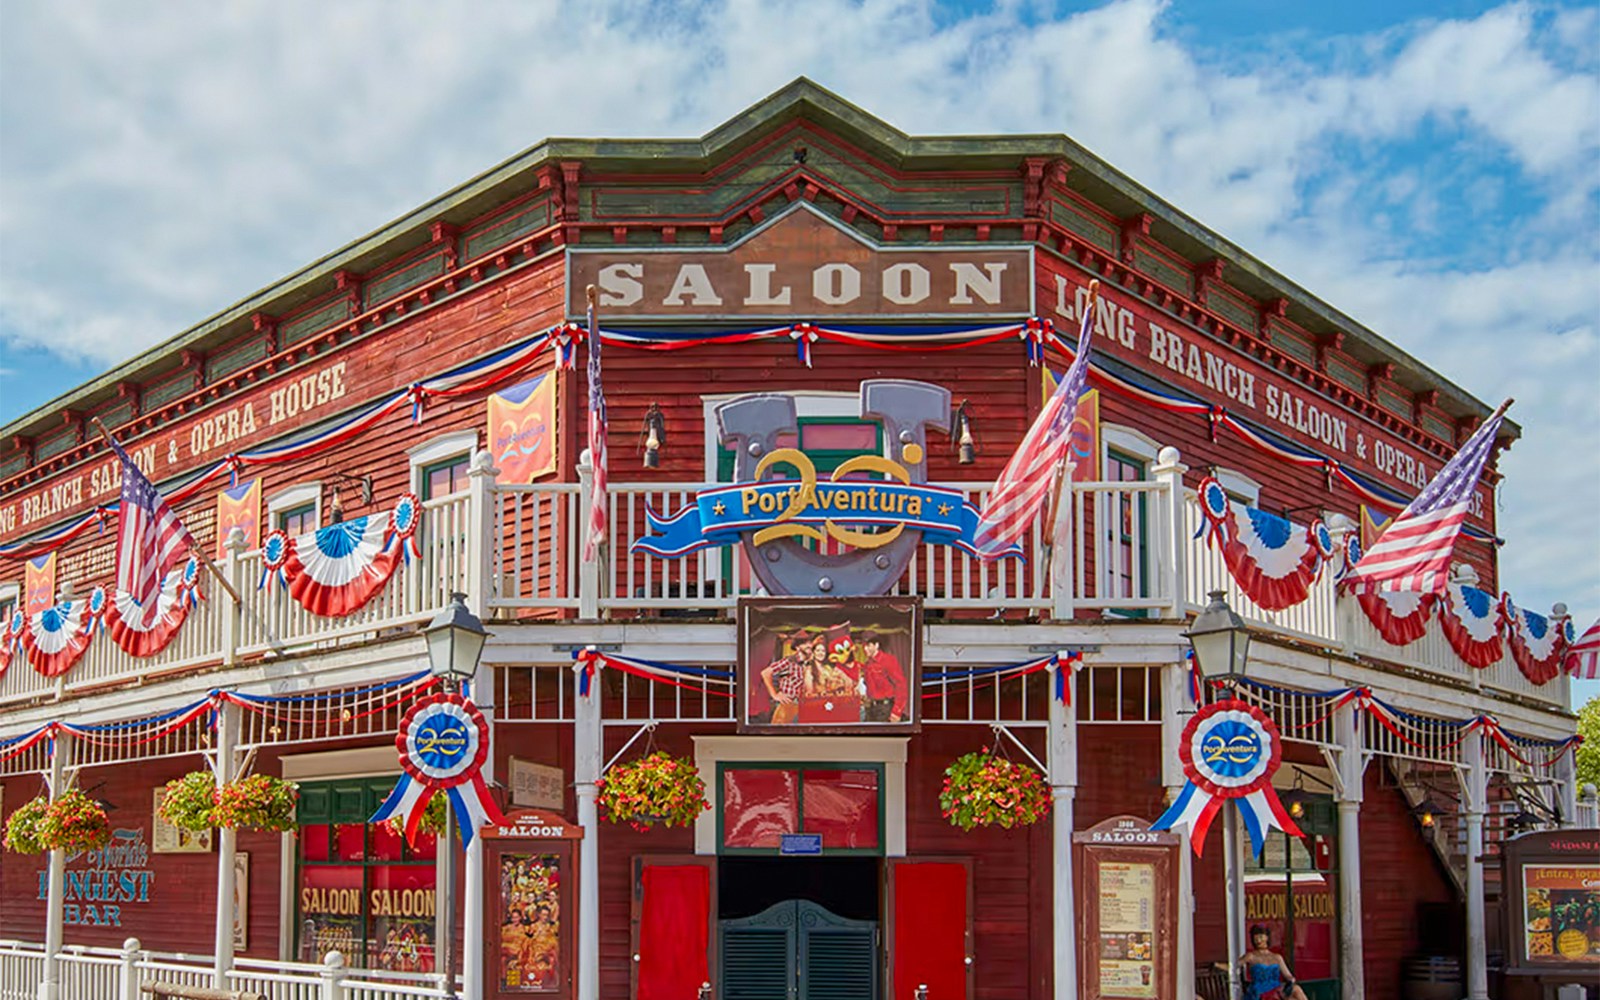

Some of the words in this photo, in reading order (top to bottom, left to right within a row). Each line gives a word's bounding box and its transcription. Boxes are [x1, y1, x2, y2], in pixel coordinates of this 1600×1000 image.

[599, 263, 1008, 306] SALOON
[1055, 274, 1136, 350] LONG
[1149, 322, 1256, 409] BRANCH
[1265, 384, 1348, 453] SALOON
[1356, 433, 1367, 460] &
[1374, 439, 1428, 490] OPERA
[22, 475, 83, 526] BRANCH
[90, 443, 157, 498] SALON
[167, 438, 179, 464] &
[190, 402, 257, 456] OPERA
[269, 361, 347, 426] HOUSE
[741, 483, 923, 516] PortAventura
[498, 825, 564, 837] SALOON
[1092, 832, 1159, 843] SALOON
[63, 903, 122, 927] BAR
[302, 887, 361, 916] SALOON
[371, 888, 436, 917] SALOON
[1293, 893, 1335, 918] SALOON
